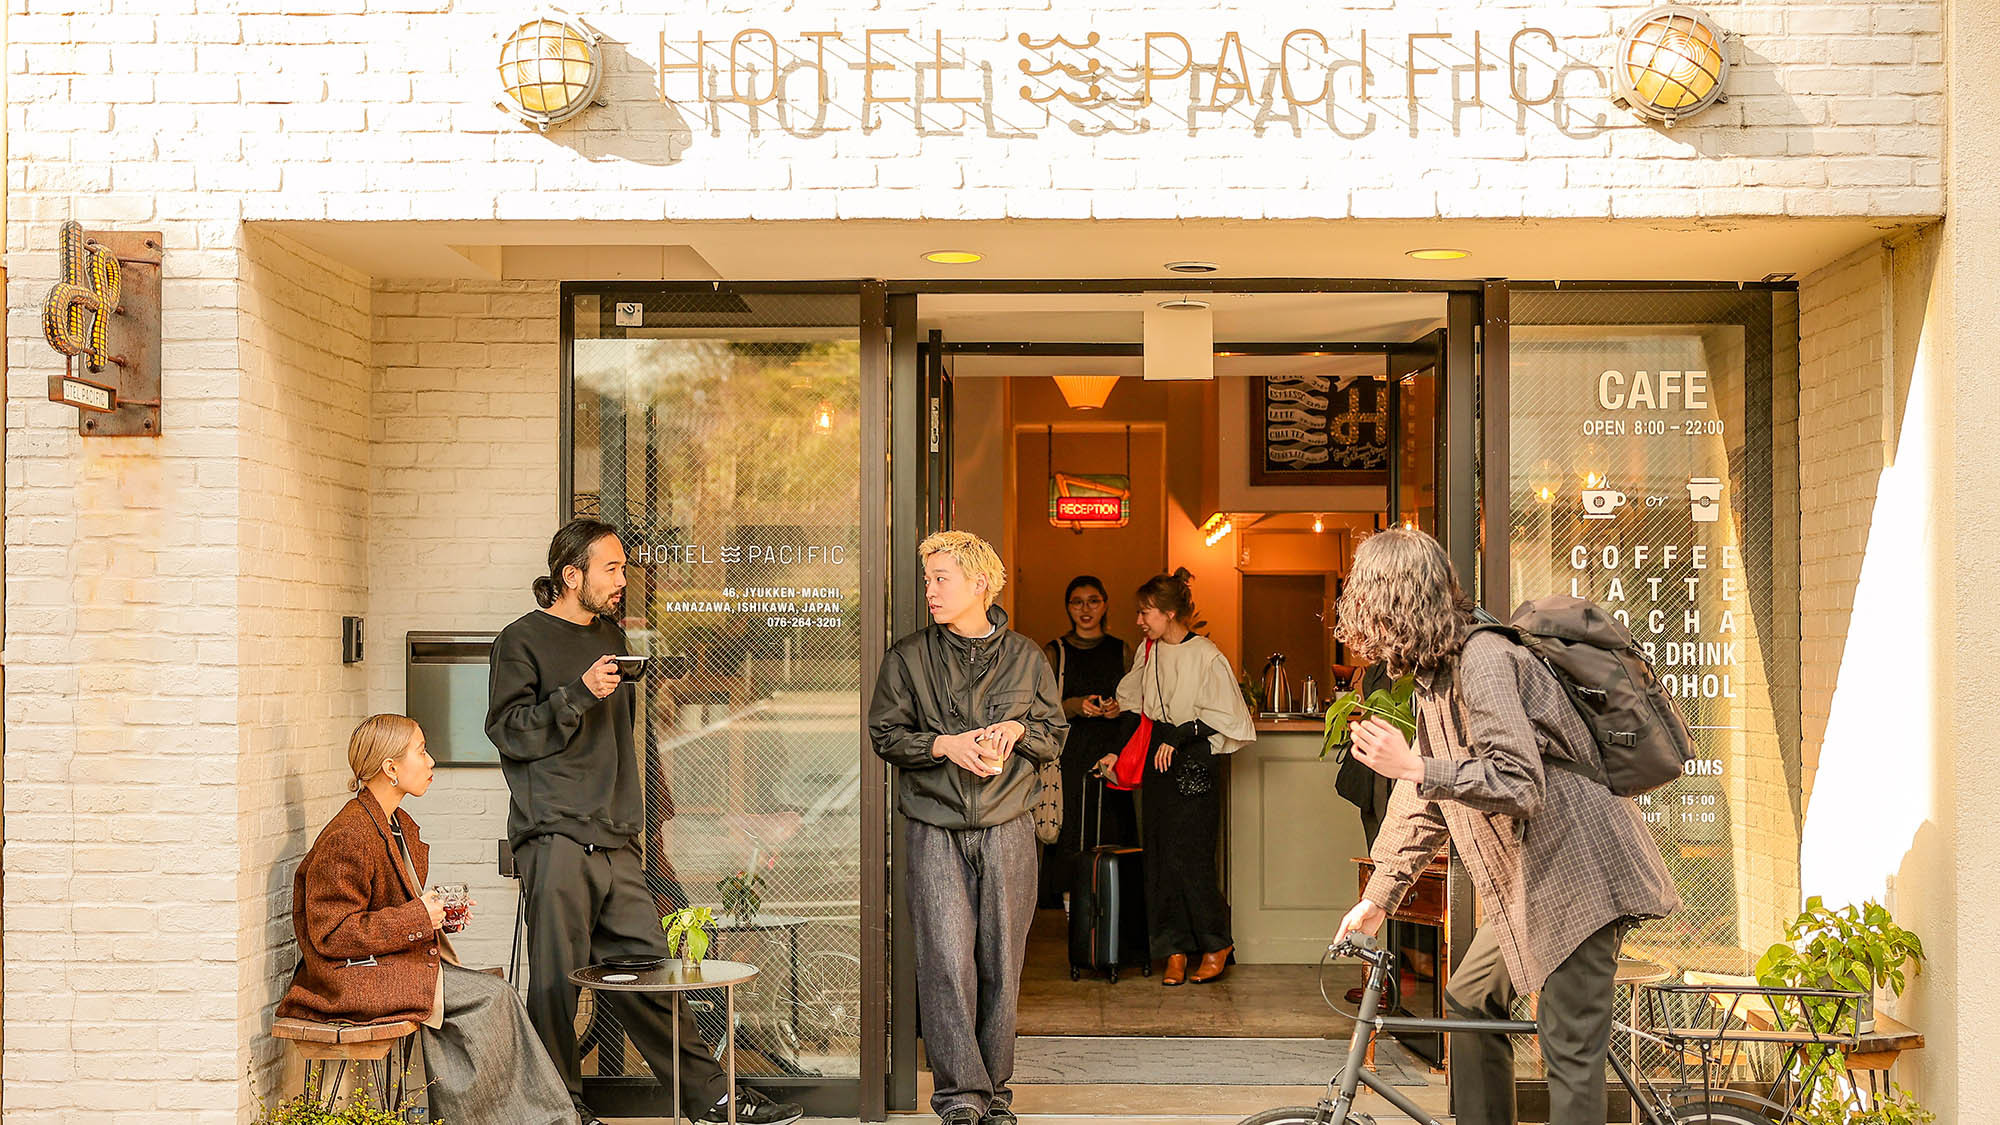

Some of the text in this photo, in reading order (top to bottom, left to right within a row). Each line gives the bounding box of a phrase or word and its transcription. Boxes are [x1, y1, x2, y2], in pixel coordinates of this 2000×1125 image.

[659, 27, 1558, 106] HOTEL PACIFIC
[66, 383, 81, 400] OTEL
[1598, 370, 1708, 410] CAFE
[1583, 420, 1625, 436] OPEN
[1634, 420, 1665, 436] 8:00
[1685, 420, 1725, 436] 22:00
[1059, 503, 1118, 515] RECEPTION
[1645, 495, 1669, 507] or
[638, 544, 845, 565] HOTEL PACIFIC
[1570, 545, 1737, 570] COFFEE
[722, 587, 845, 600] 46, JYUKKEN-MACHI,
[1571, 577, 1737, 601] LATTE
[666, 602, 844, 614] KANAZAWA, ISHIKAWA, JAPAN.
[767, 617, 842, 628] 076-264-3201
[1613, 609, 1737, 634] OCHA
[1642, 641, 1737, 666] R DRINK
[1662, 673, 1737, 698] OHOL
[1684, 759, 1724, 776] OMS
[1632, 794, 1715, 806] -IN 15:00
[1680, 812, 1715, 823] 11:00
